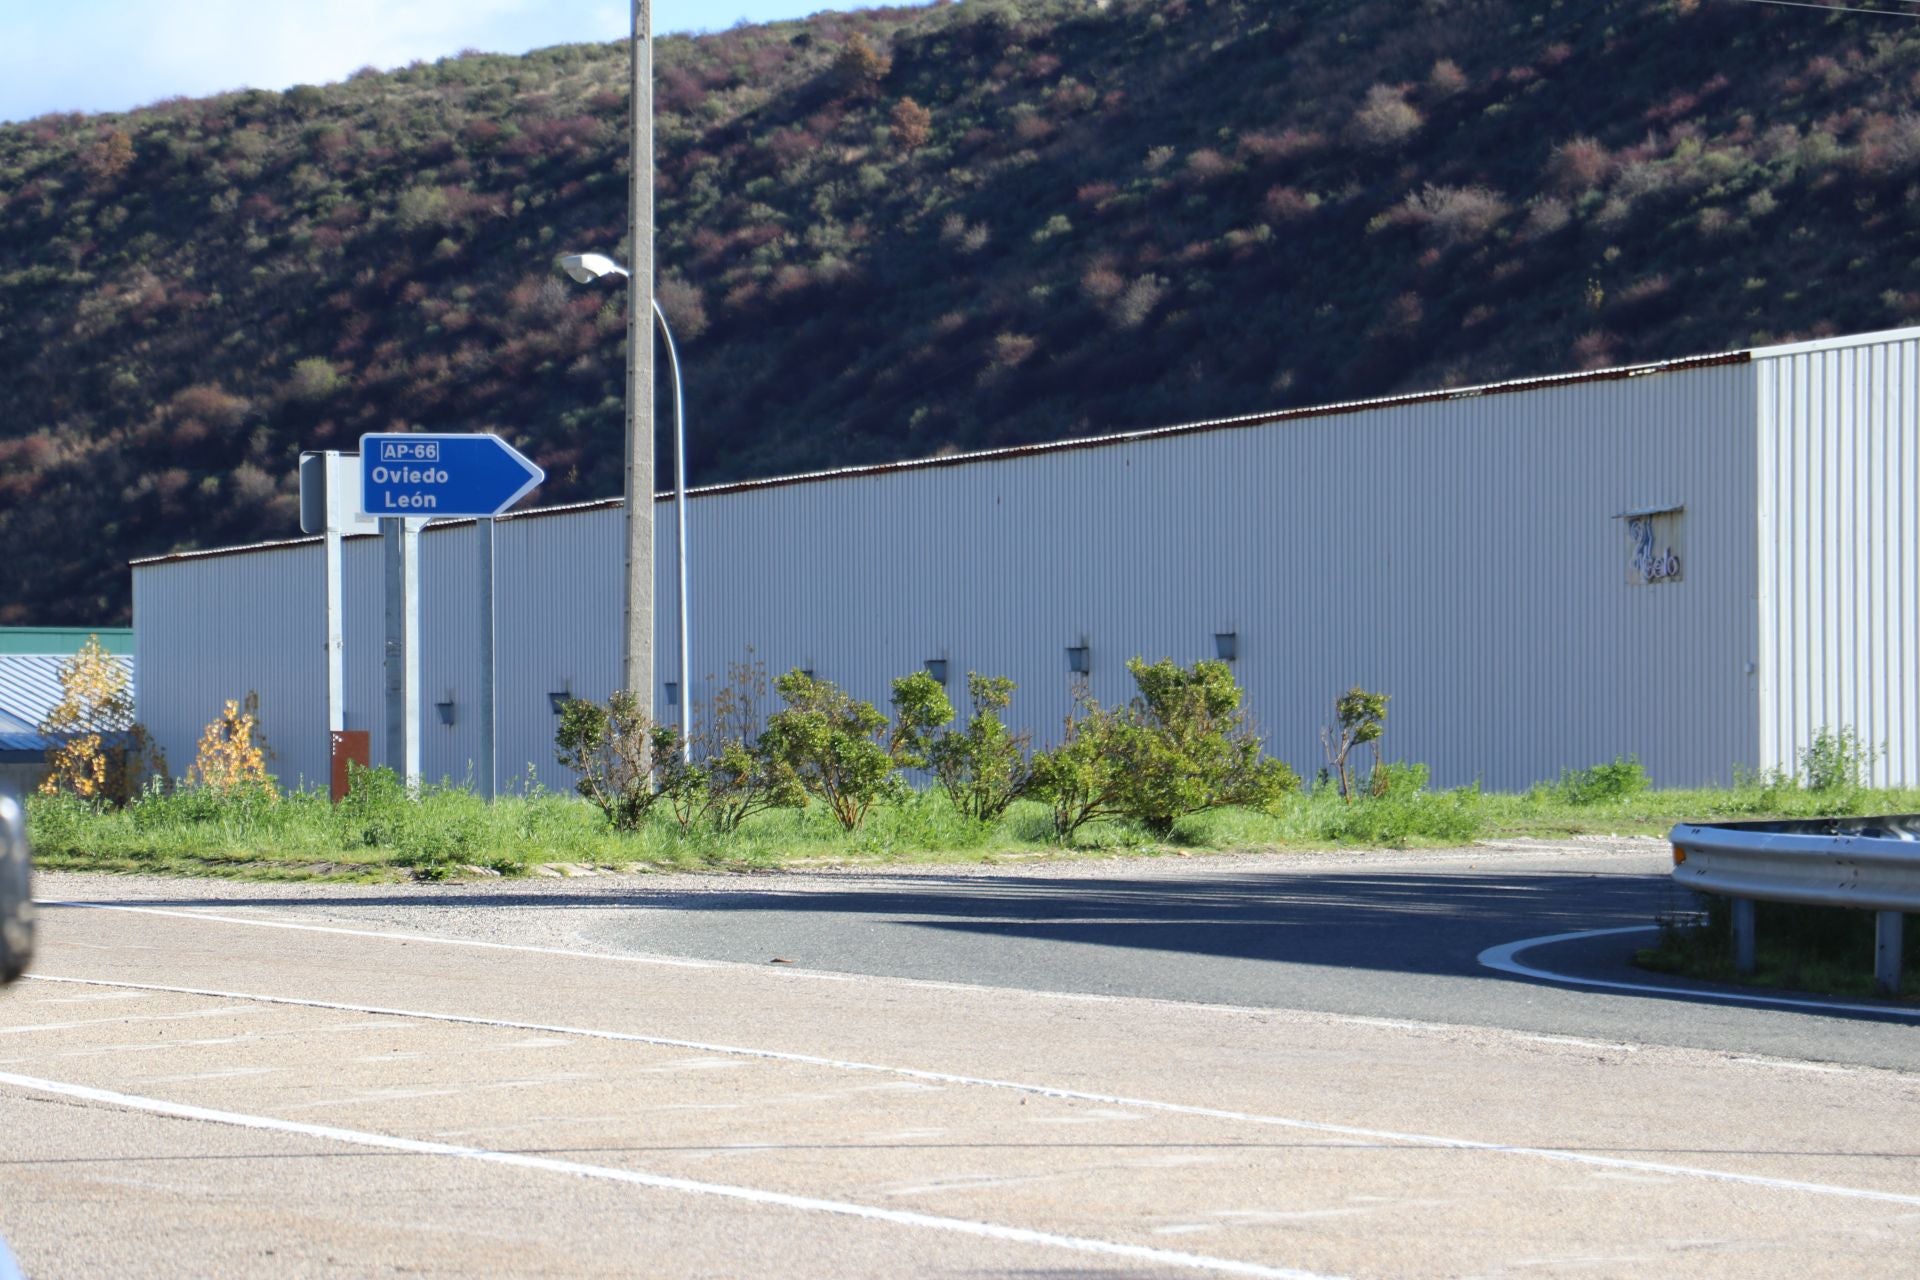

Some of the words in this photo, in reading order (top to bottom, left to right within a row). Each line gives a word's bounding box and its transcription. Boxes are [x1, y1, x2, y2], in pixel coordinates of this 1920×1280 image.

[384, 444, 436, 459] AP-66
[372, 466, 449, 484] Oviedo
[385, 491, 437, 508] León
